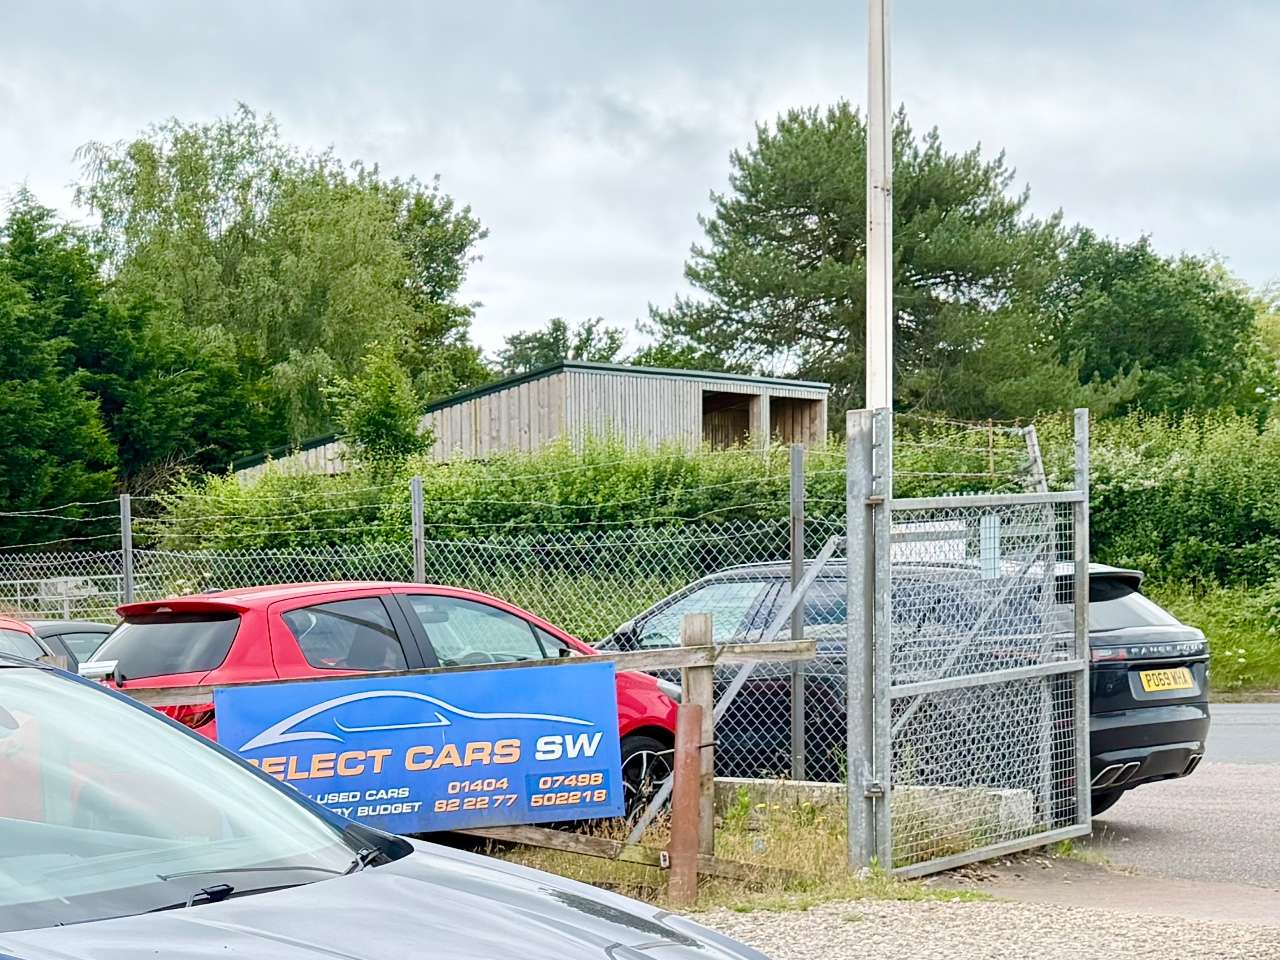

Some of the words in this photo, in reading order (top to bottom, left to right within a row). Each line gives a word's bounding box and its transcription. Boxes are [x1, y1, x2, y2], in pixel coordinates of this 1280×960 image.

[245, 749, 392, 782] ELECT
[405, 738, 521, 771] CARS
[534, 731, 603, 761] SW
[447, 777, 509, 794] 01404
[538, 772, 604, 790] 07498
[316, 791, 361, 804] USED
[365, 787, 410, 800] CARS
[530, 789, 608, 807] 502218
[357, 801, 423, 818] BUDGET
